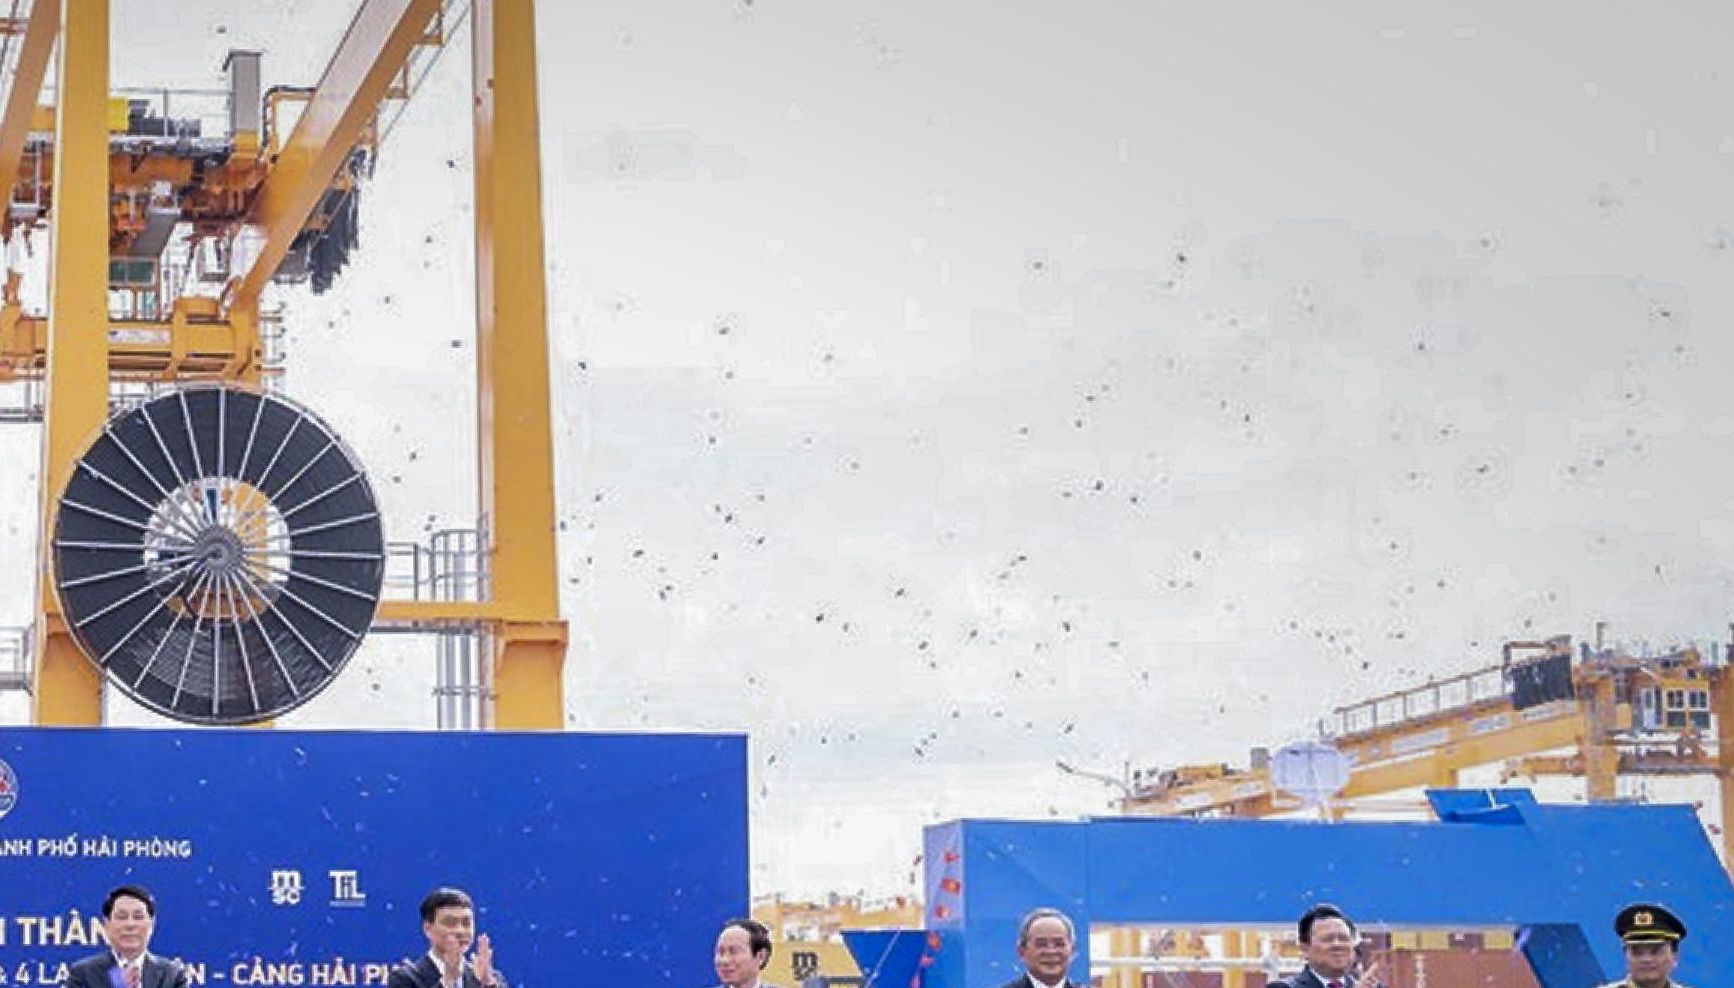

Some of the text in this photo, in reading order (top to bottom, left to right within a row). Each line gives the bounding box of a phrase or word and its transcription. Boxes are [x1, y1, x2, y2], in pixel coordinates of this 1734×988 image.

[38, 832, 78, 857] PHỐ
[82, 834, 116, 857] HẢI
[123, 835, 192, 858] PHÒNG
[15, 907, 111, 946] THÀN
[15, 961, 30, 985] 4
[232, 955, 305, 986] CẢNG
[311, 956, 357, 986] HẢI
